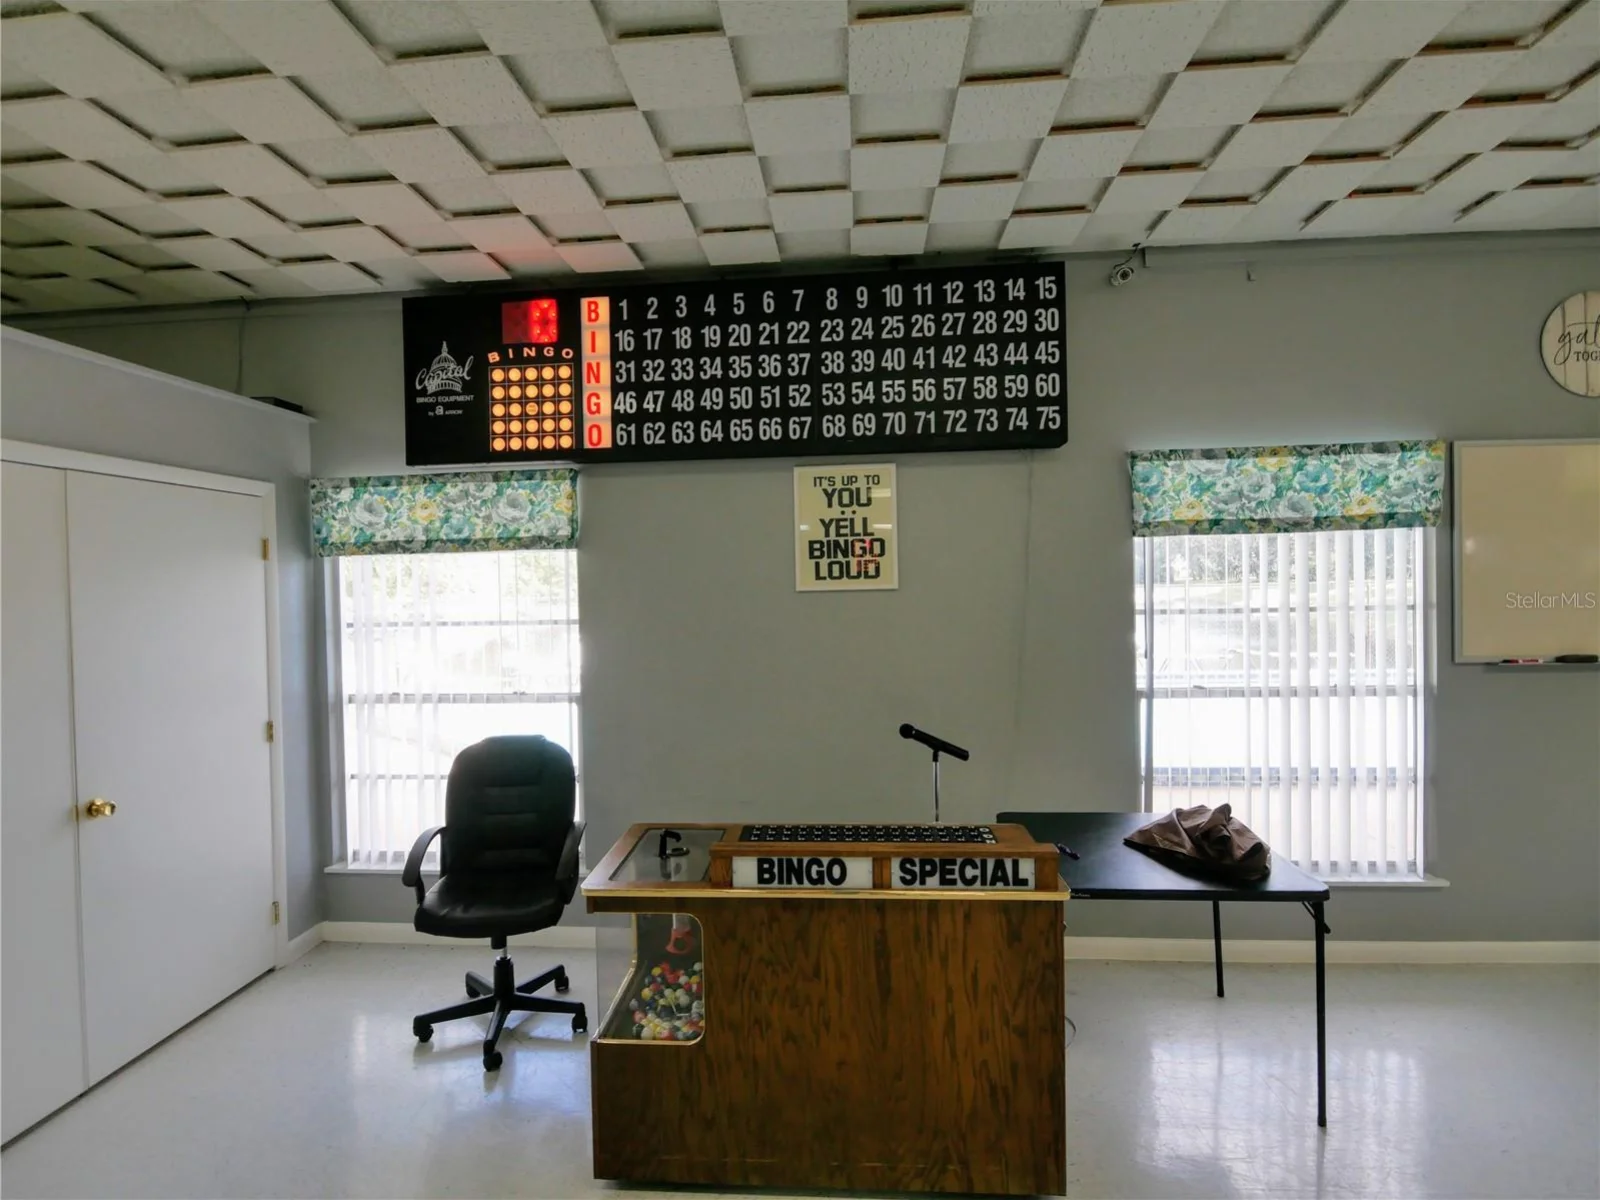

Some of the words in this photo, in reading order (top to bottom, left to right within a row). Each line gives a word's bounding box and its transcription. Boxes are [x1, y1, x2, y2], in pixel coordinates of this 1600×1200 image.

[618, 298, 628, 321] 1
[647, 296, 659, 320] 2
[675, 295, 687, 318] 3
[704, 294, 716, 316] 4
[733, 292, 745, 315] 5
[763, 290, 775, 314] 6
[792, 289, 805, 312] 7
[826, 287, 838, 311] 8
[856, 286, 868, 309] 9
[881, 284, 903, 307] 10
[913, 282, 932, 306] 11
[942, 280, 964, 304] 12
[973, 279, 996, 303] 13
[1003, 277, 1026, 301] 14
[1034, 276, 1057, 300] 15
[614, 328, 635, 352] 16
[642, 327, 663, 351] 17
[671, 326, 692, 350] 18
[700, 324, 721, 348] 19
[728, 323, 752, 347] 20
[758, 322, 779, 346] 21
[786, 320, 810, 344] 22
[820, 318, 845, 342] 23
[851, 317, 875, 341] 24
[881, 315, 905, 339] 25
[911, 313, 936, 338] 26
[941, 312, 966, 336] 27
[972, 310, 998, 335] 28
[1002, 309, 1028, 333] 29
[1034, 307, 1060, 332] 30
[615, 360, 636, 384] 31
[642, 358, 665, 383] 32
[670, 357, 695, 382] 33
[699, 356, 723, 380] 34
[728, 355, 753, 379] 35
[758, 353, 782, 378] 36
[787, 352, 811, 377] 37
[820, 350, 845, 375] 38
[851, 348, 875, 373] 39
[881, 347, 906, 372] 40
[912, 346, 935, 370] 41
[941, 344, 967, 368] 42
[973, 342, 999, 367] 43
[1003, 341, 1029, 366] 44
[1034, 340, 1060, 365] 45
[613, 390, 638, 414] 46
[642, 390, 665, 413] 47
[671, 388, 695, 412] 48
[700, 387, 724, 411] 49
[729, 386, 753, 410] 50
[760, 385, 781, 409] 51
[788, 383, 812, 408] 52
[821, 382, 846, 406] 53
[851, 380, 876, 405] 54
[881, 379, 906, 404] 55
[912, 377, 937, 403] 56
[943, 376, 967, 401] 57
[973, 375, 998, 400] 58
[1004, 373, 1029, 399] 59
[1035, 372, 1061, 398] 60
[615, 423, 636, 446] 61
[642, 421, 666, 445] 62
[671, 420, 695, 444] 63
[700, 419, 724, 443] 64
[729, 418, 754, 442] 65
[758, 416, 783, 441] 66
[788, 416, 812, 440] 67
[822, 413, 847, 438] 68
[852, 412, 876, 437] 69
[882, 411, 907, 436] 70
[913, 410, 936, 434] 71
[942, 409, 968, 433] 72
[973, 407, 999, 432] 73
[1005, 406, 1029, 431] 74
[1036, 405, 1061, 430] 75
[813, 475, 836, 488] IT'S
[841, 475, 858, 487] UP
[864, 474, 881, 486] TO
[821, 486, 873, 509] YOU
[818, 516, 875, 538] YELL
[808, 537, 886, 560] BINGO
[814, 559, 881, 581] LOUD
[756, 857, 848, 886] BINGO
[899, 857, 1029, 887] SPECIAL
